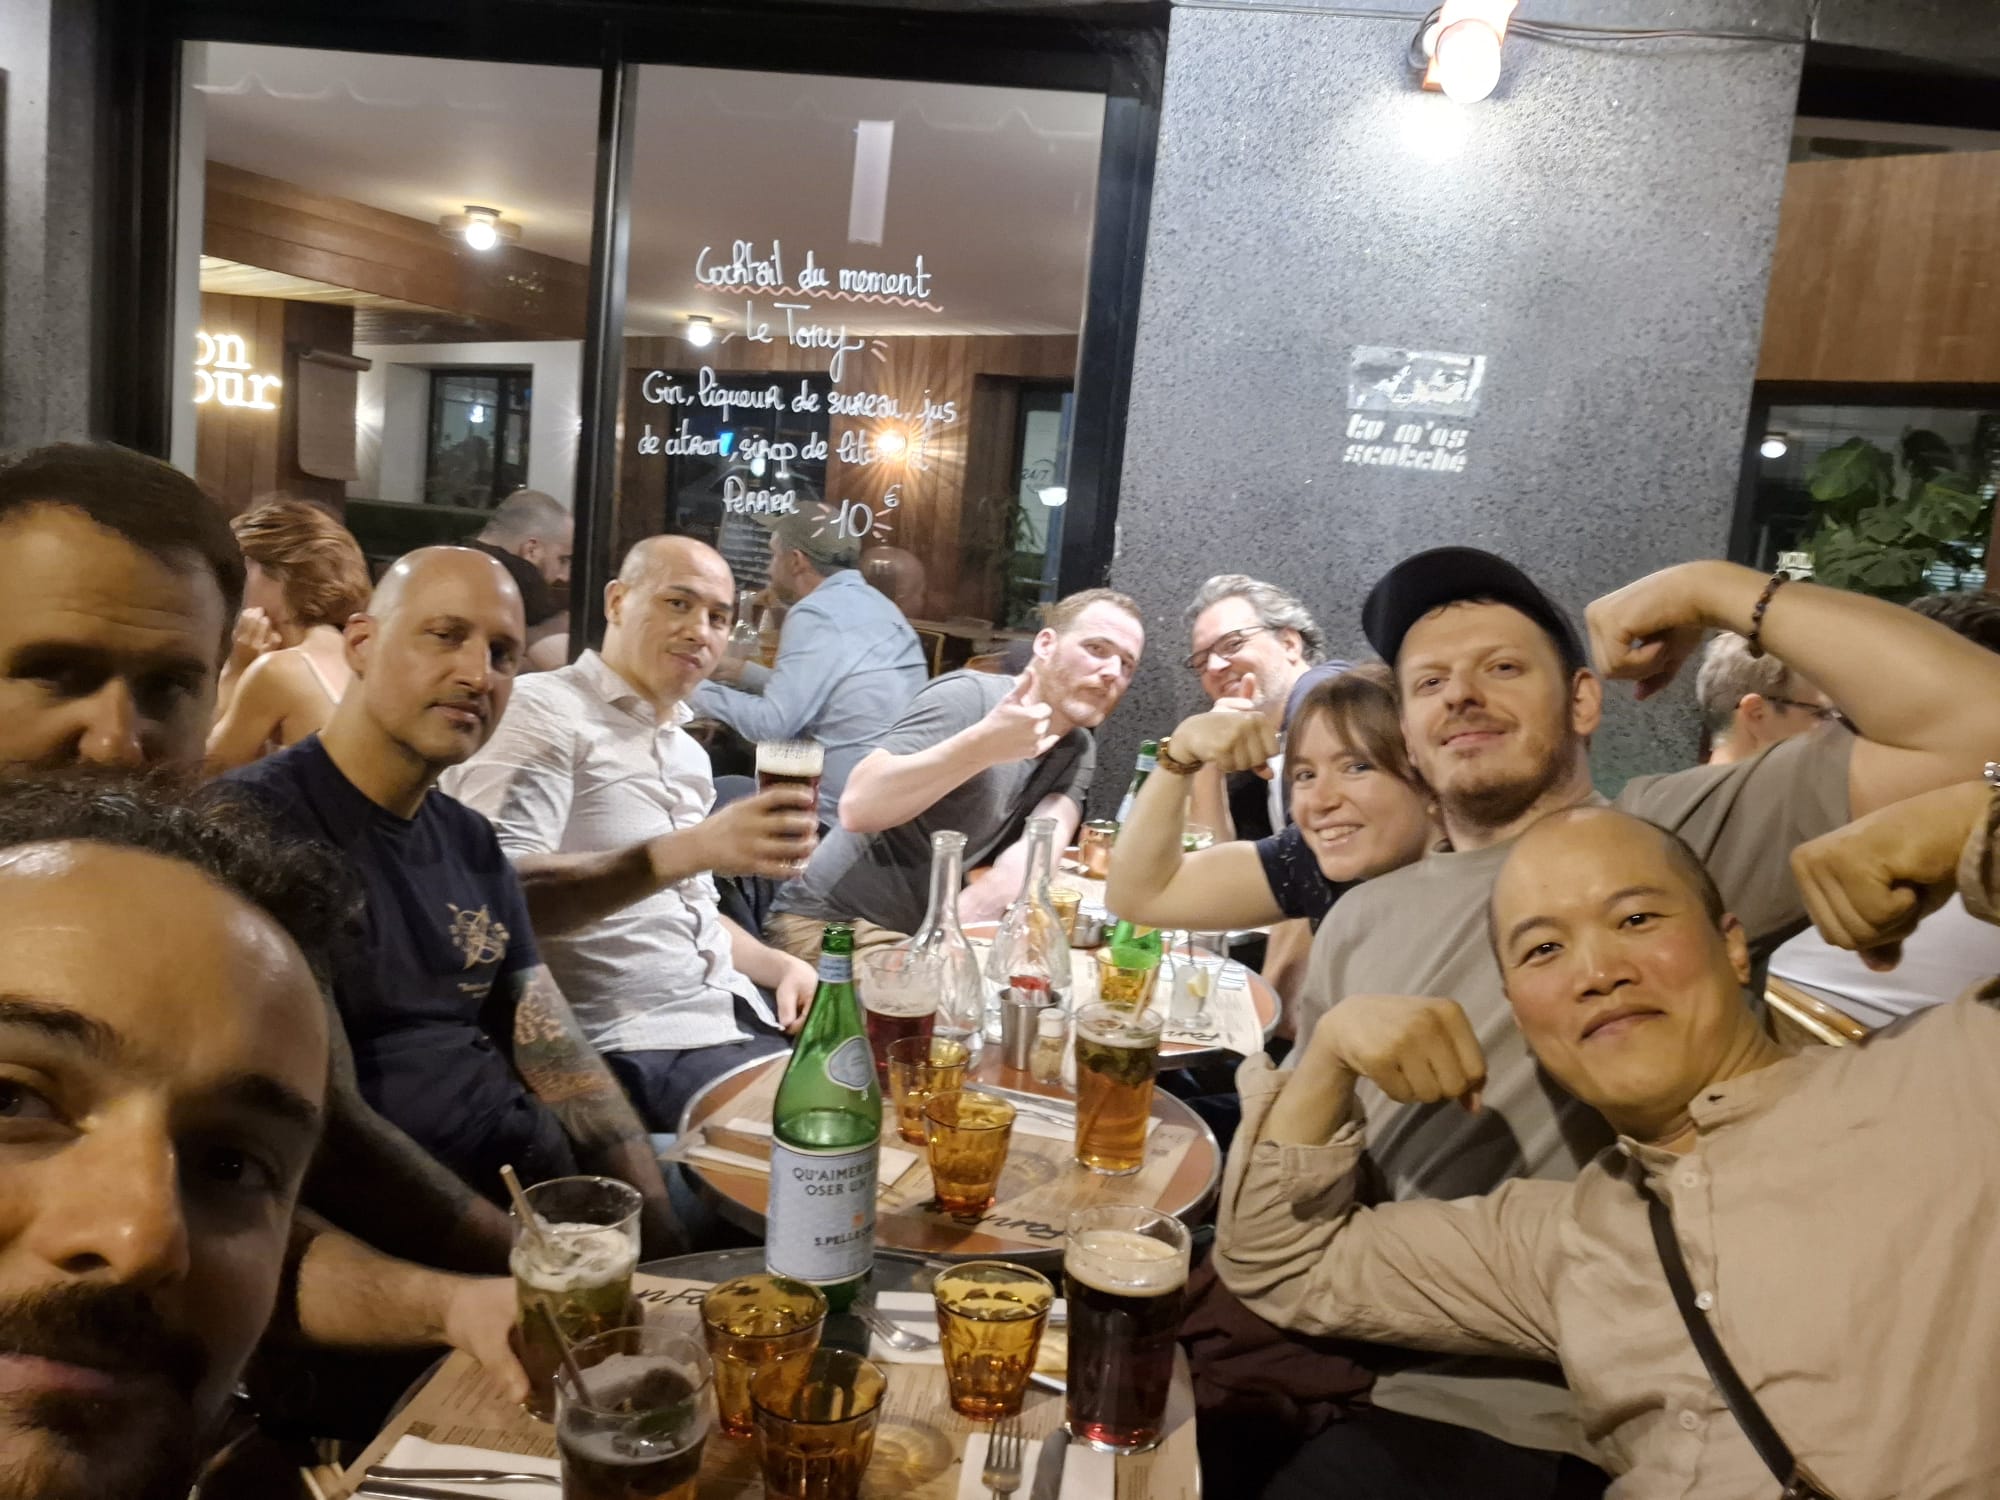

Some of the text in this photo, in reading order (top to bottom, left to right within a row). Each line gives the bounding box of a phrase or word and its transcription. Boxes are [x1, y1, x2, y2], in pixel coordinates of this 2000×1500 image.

[798, 249, 830, 289] du
[838, 253, 932, 298] moment
[773, 301, 865, 383] Tony
[791, 379, 822, 414] de
[919, 388, 958, 432] jus
[637, 424, 662, 456] de
[800, 431, 830, 462] de
[805, 1182, 844, 1196] OSER
